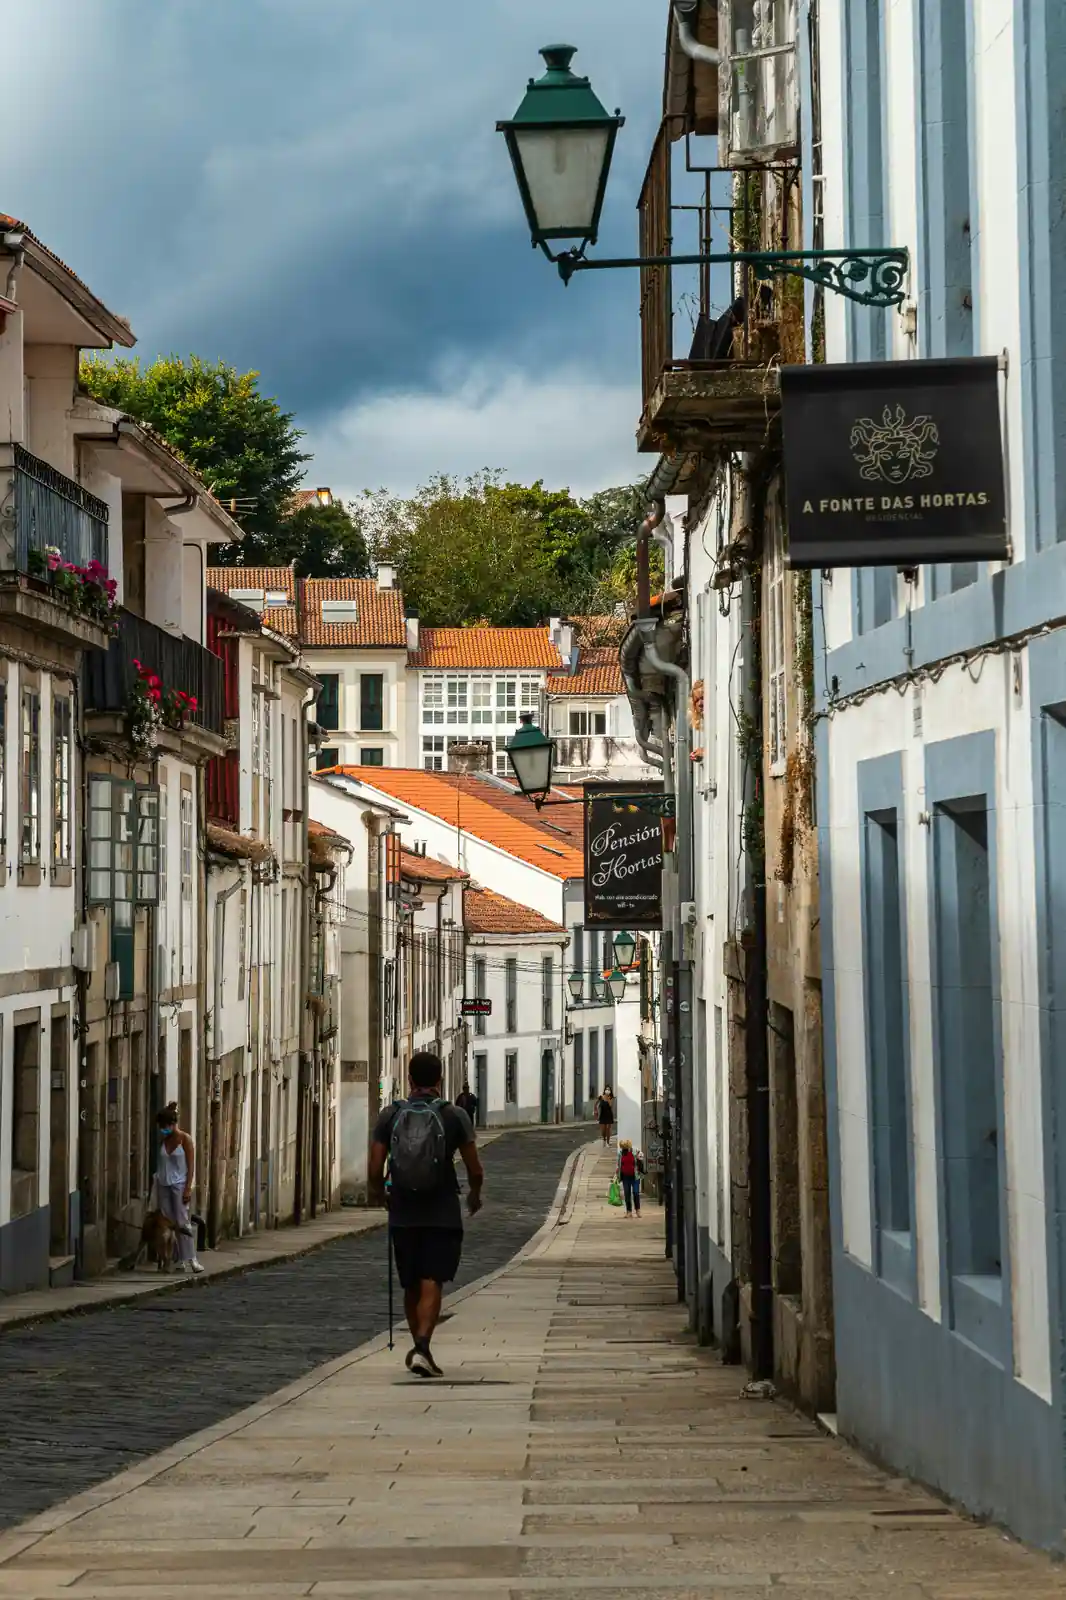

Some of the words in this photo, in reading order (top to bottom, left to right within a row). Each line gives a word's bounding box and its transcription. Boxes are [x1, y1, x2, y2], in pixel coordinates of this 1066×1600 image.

[802, 501, 814, 513] A
[820, 497, 875, 512] FONTE
[881, 496, 914, 510] DAS
[920, 492, 987, 507] HORTAS
[591, 822, 661, 857] Pensión
[592, 853, 662, 887] Hortas
